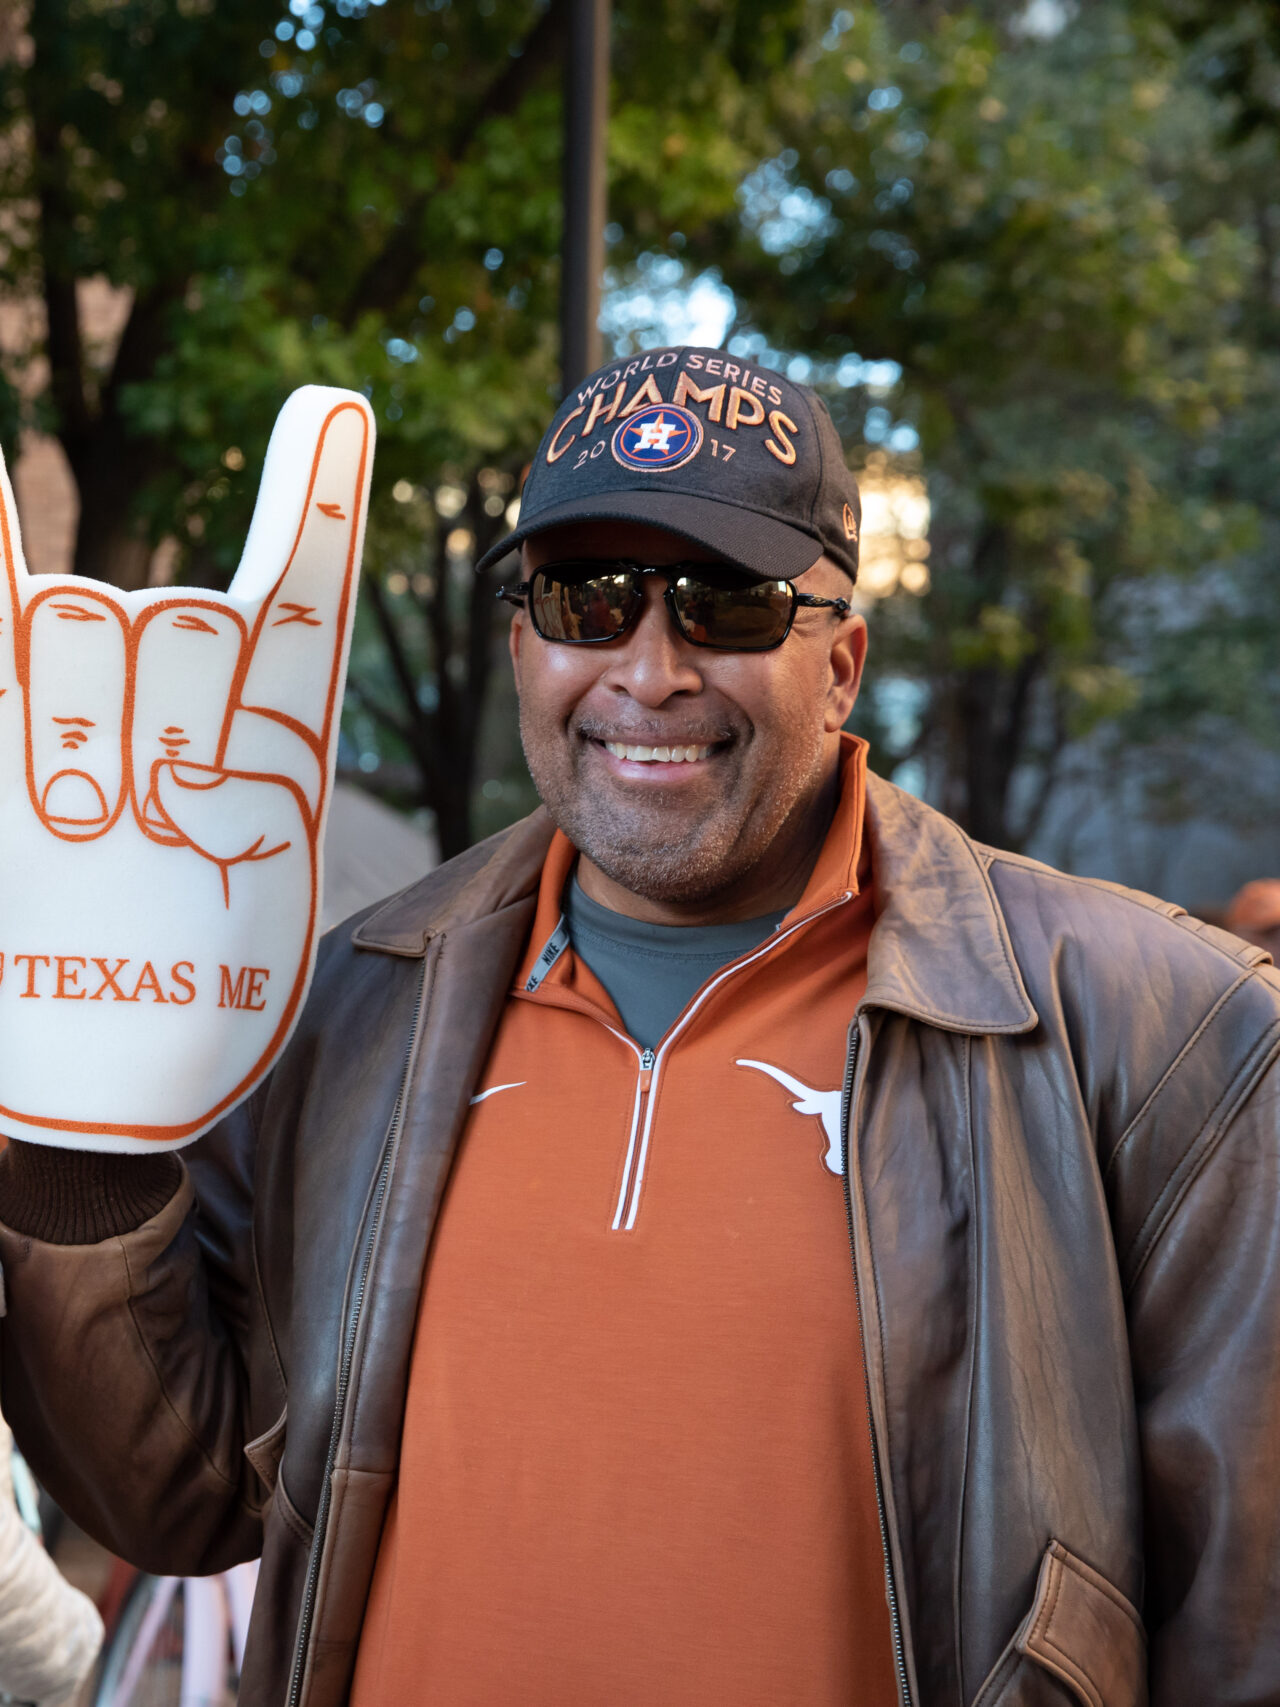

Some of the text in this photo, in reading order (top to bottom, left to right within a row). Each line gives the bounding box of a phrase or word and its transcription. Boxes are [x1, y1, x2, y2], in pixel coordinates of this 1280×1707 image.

[578, 353, 782, 405] WORLD SERIES
[546, 371, 799, 466] CHAMPS
[573, 438, 736, 470] 20 17
[541, 943, 560, 966] NIKE
[14, 954, 270, 1011] TEXAS ME
